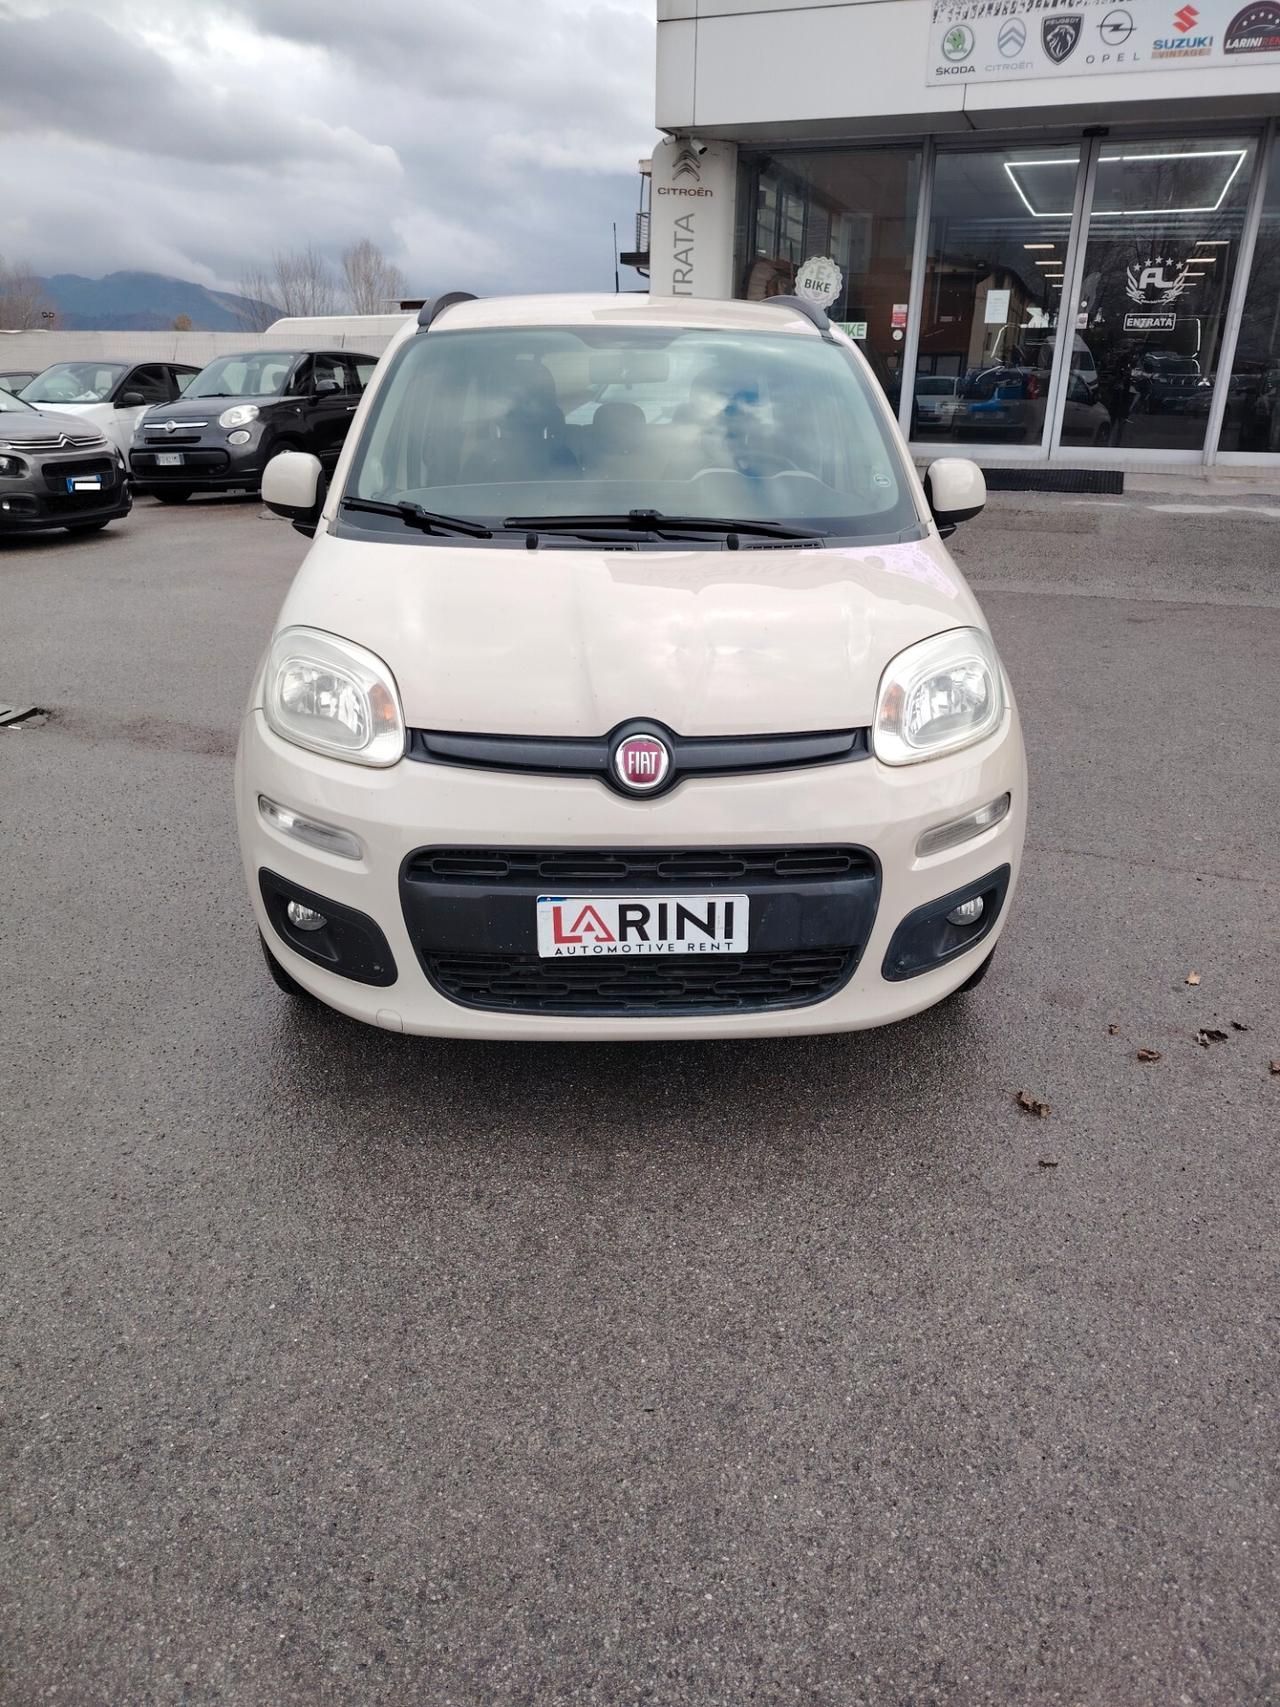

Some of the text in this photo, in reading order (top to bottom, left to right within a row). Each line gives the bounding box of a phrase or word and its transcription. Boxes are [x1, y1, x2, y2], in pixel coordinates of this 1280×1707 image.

[1151, 36, 1214, 50] SUZUKI
[1085, 52, 1140, 64] OPEL
[1157, 48, 1204, 58] VINTAGE
[935, 65, 976, 76] ŠKODA
[657, 187, 714, 197] CITROËN
[804, 278, 832, 294] BIKE
[1126, 317, 1173, 328] ENTRATA
[628, 751, 658, 775] FIAT
[552, 901, 735, 945] LARINI
[554, 941, 734, 956] AUTOMOTIVE RENT
